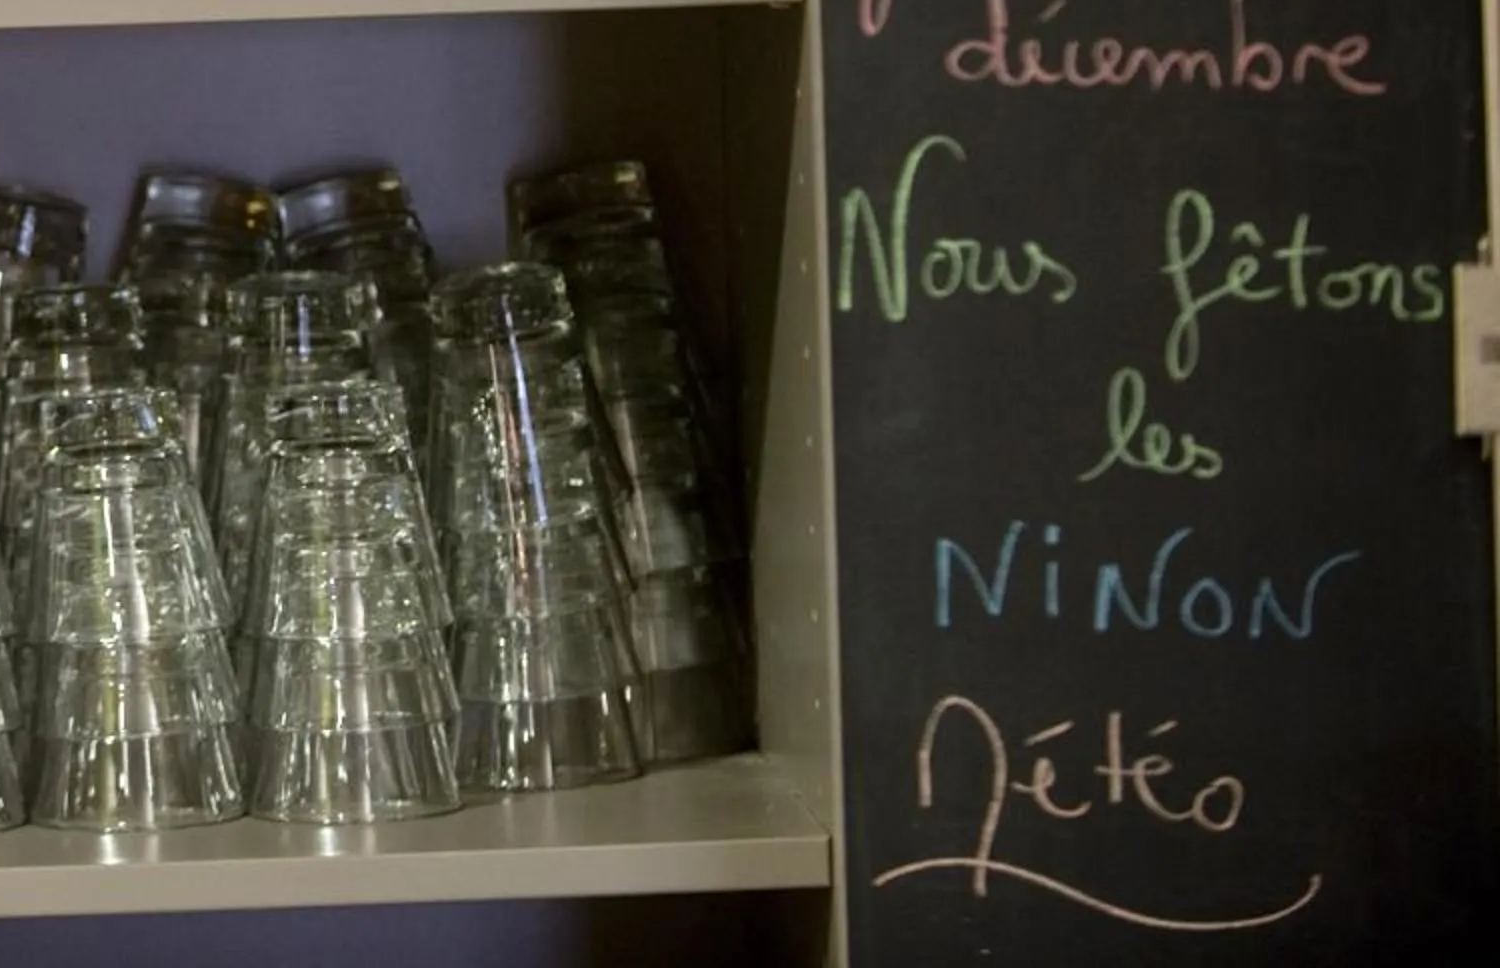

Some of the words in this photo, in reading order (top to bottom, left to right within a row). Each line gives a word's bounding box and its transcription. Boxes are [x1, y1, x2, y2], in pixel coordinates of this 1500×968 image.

[838, 135, 1076, 322] Nous
[1160, 189, 1444, 381] fêtons
[1076, 367, 1223, 481] les
